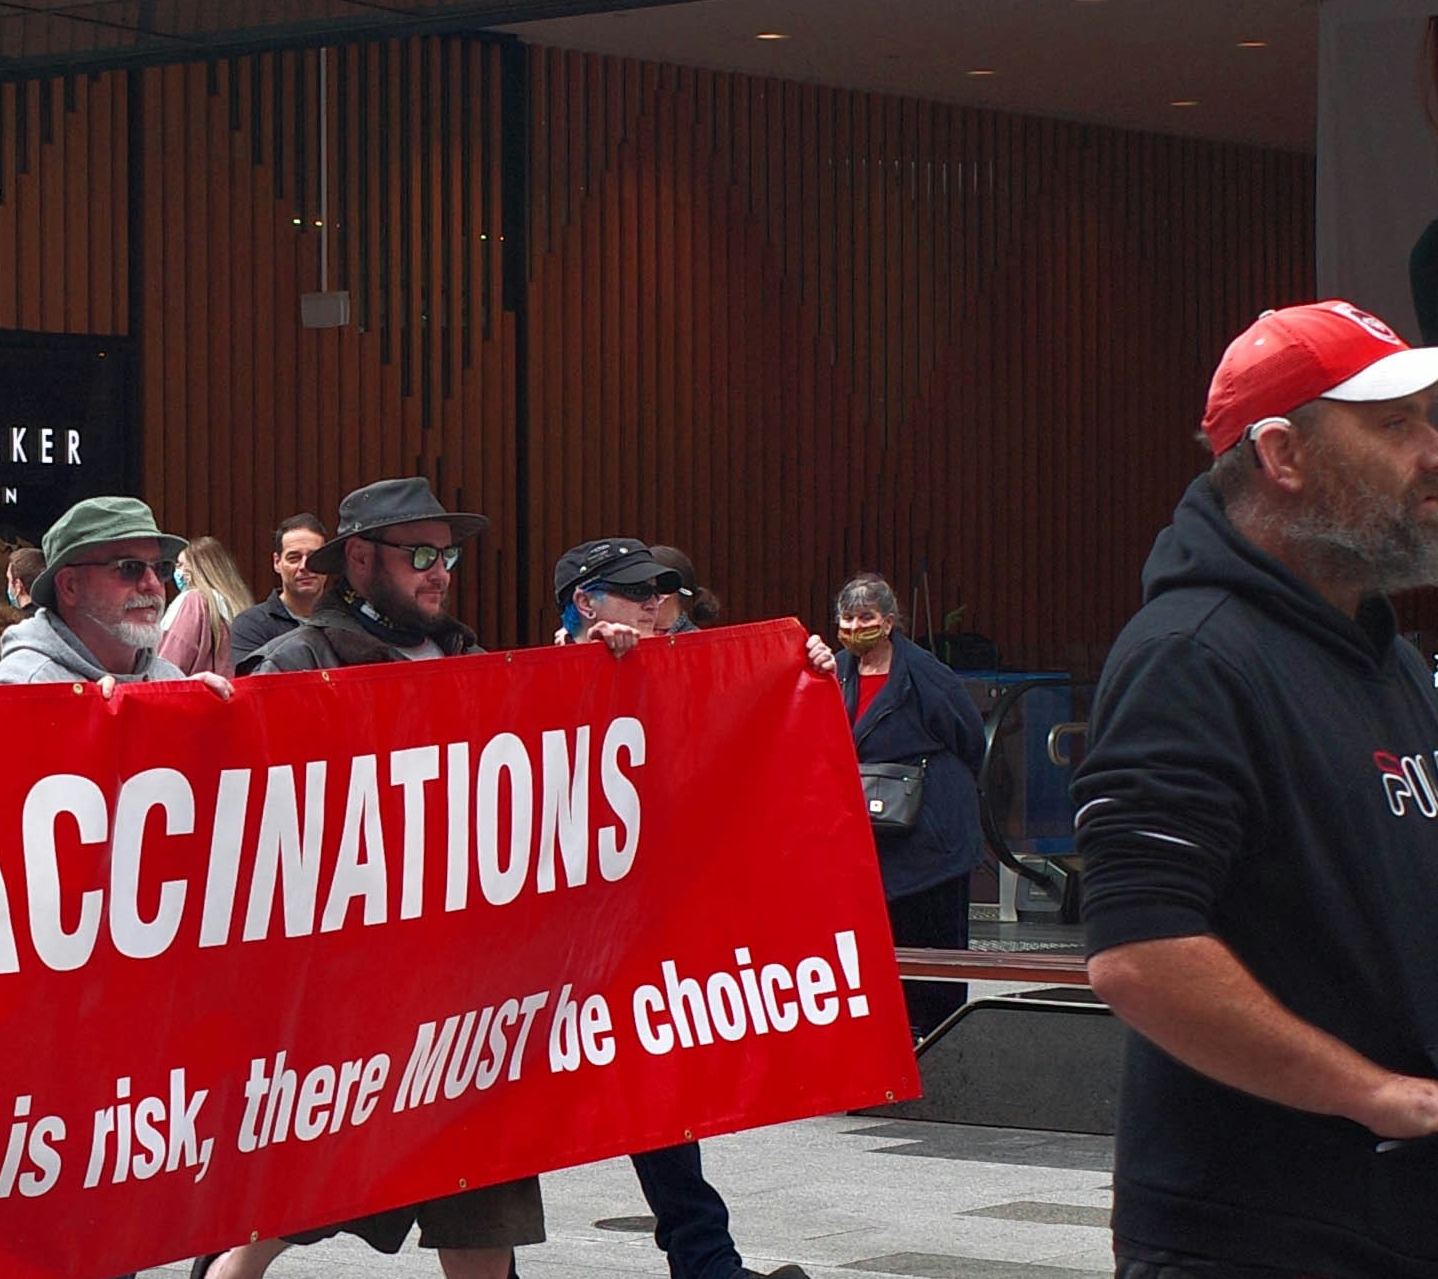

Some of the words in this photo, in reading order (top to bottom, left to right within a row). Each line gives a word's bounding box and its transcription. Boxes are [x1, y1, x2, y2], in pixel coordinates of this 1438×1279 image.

[83, 1076, 212, 1190] risk,
[240, 1051, 392, 1148] there
[393, 984, 547, 1113] MUST
[548, 984, 615, 1074] be
[632, 930, 870, 1056] choice!
